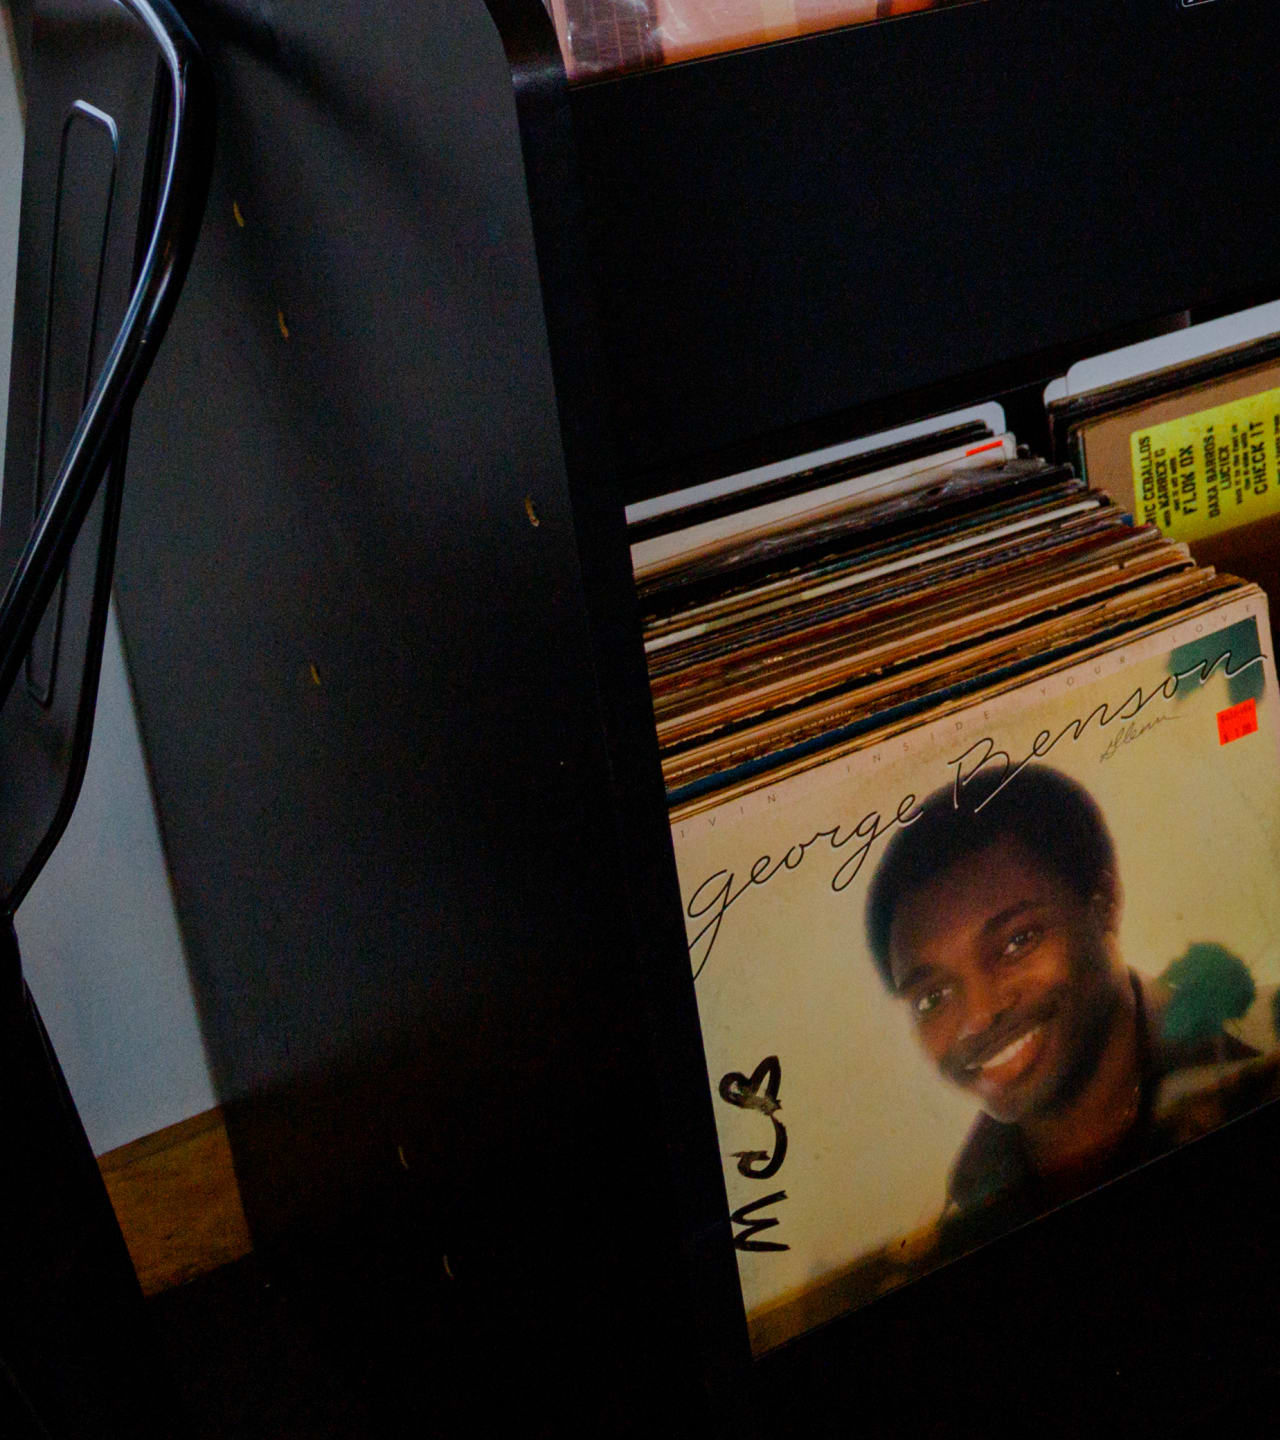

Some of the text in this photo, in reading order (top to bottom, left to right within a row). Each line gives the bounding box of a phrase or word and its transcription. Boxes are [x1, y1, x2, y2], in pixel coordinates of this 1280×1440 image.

[1249, 421, 1268, 495] CHECK IT
[680, 794, 777, 839] IVIN
[847, 710, 990, 772] INSIDE
[1041, 655, 1126, 697] YOUR
[947, 646, 1268, 814] Benson
